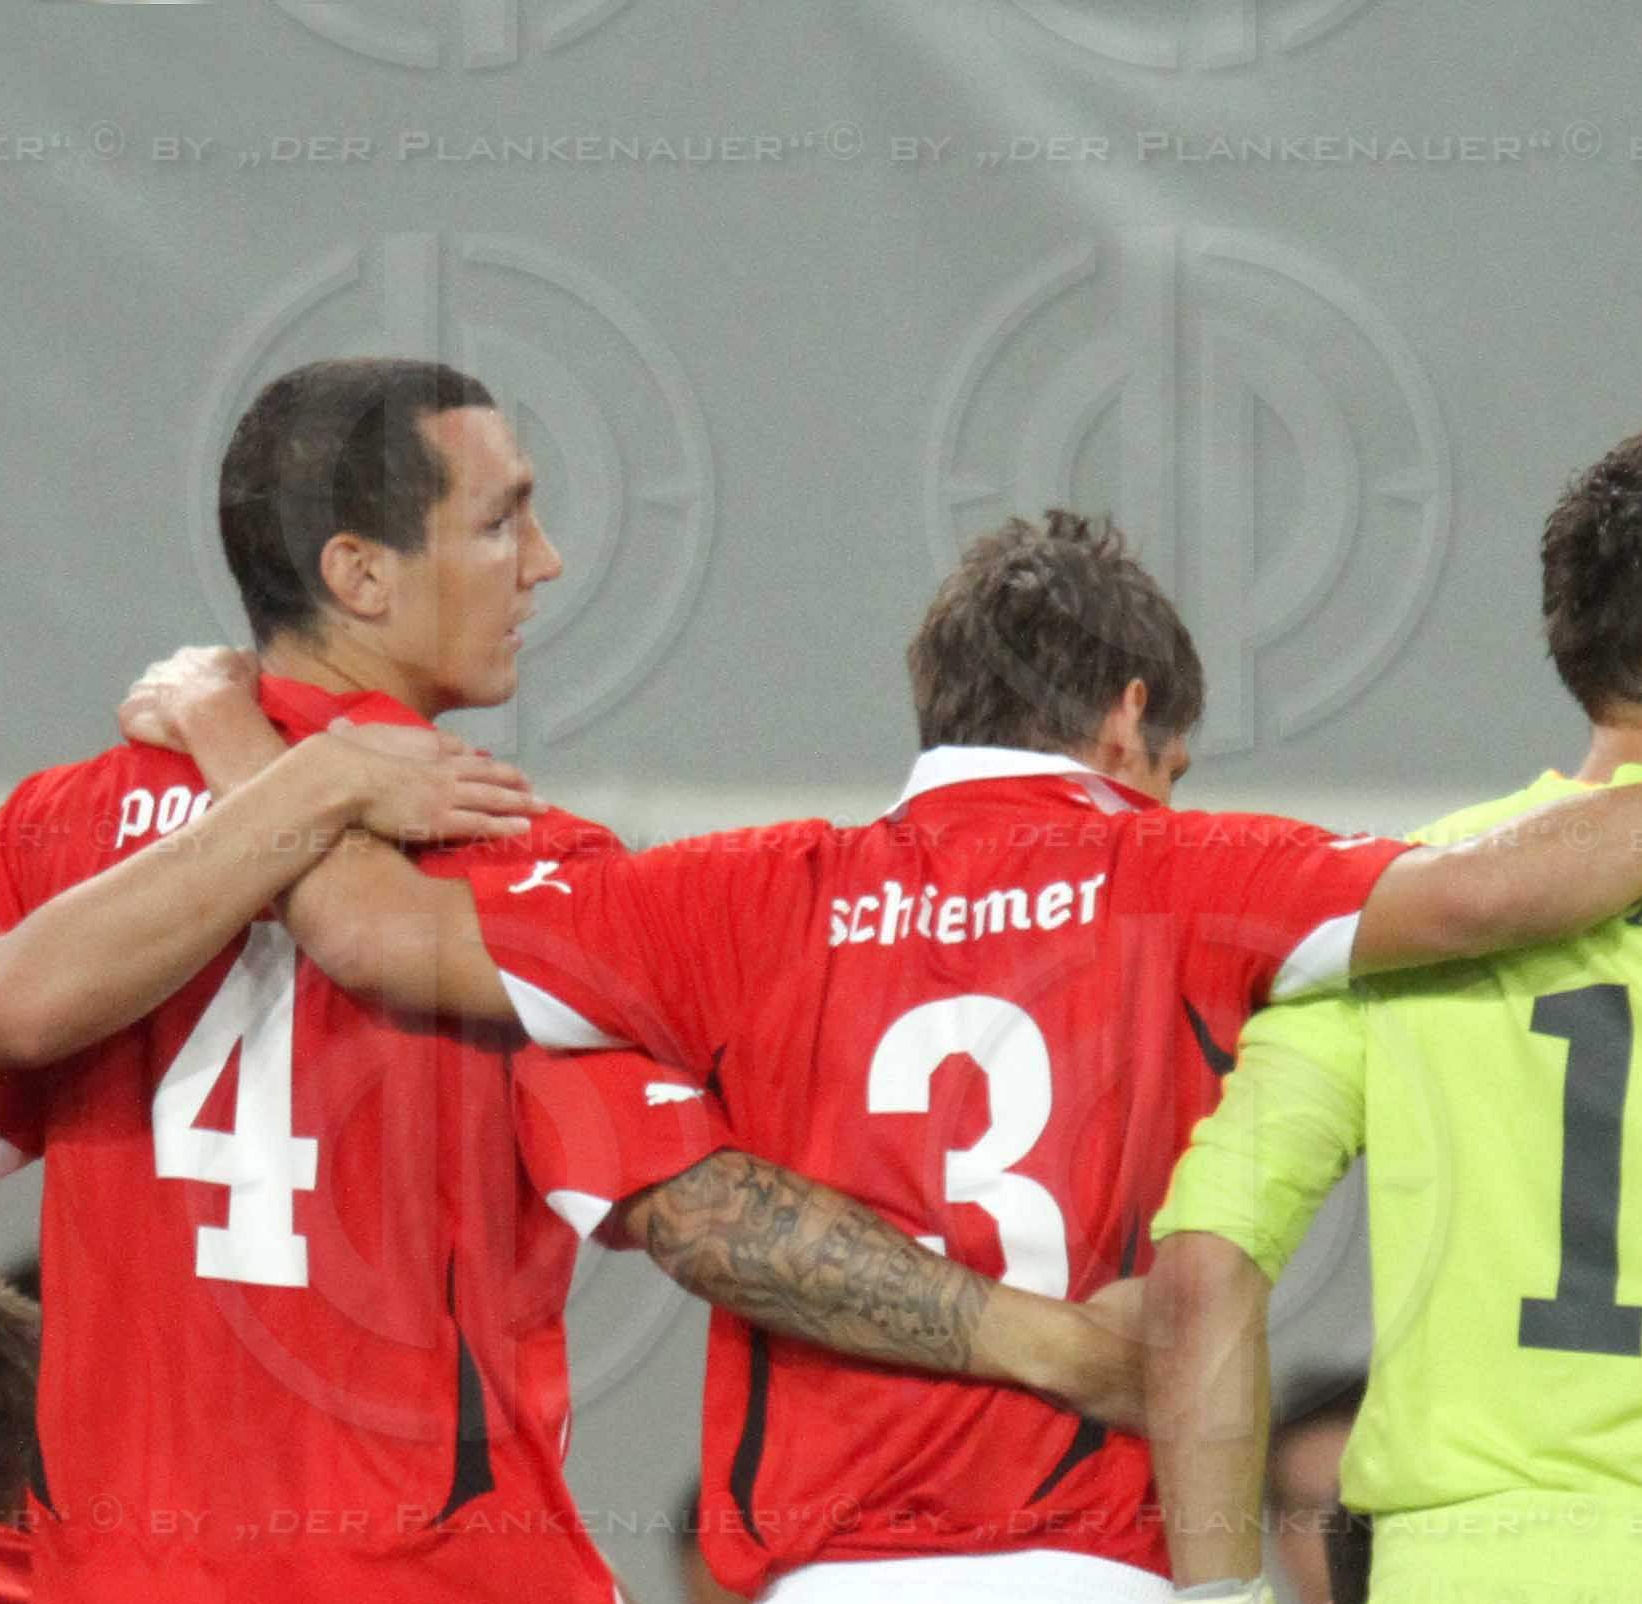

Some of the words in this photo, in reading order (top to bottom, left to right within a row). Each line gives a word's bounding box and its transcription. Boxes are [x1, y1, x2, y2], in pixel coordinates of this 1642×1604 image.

[829, 872, 1107, 947] schiemer
[151, 920, 319, 1288] 4
[866, 993, 1070, 1302] 3
